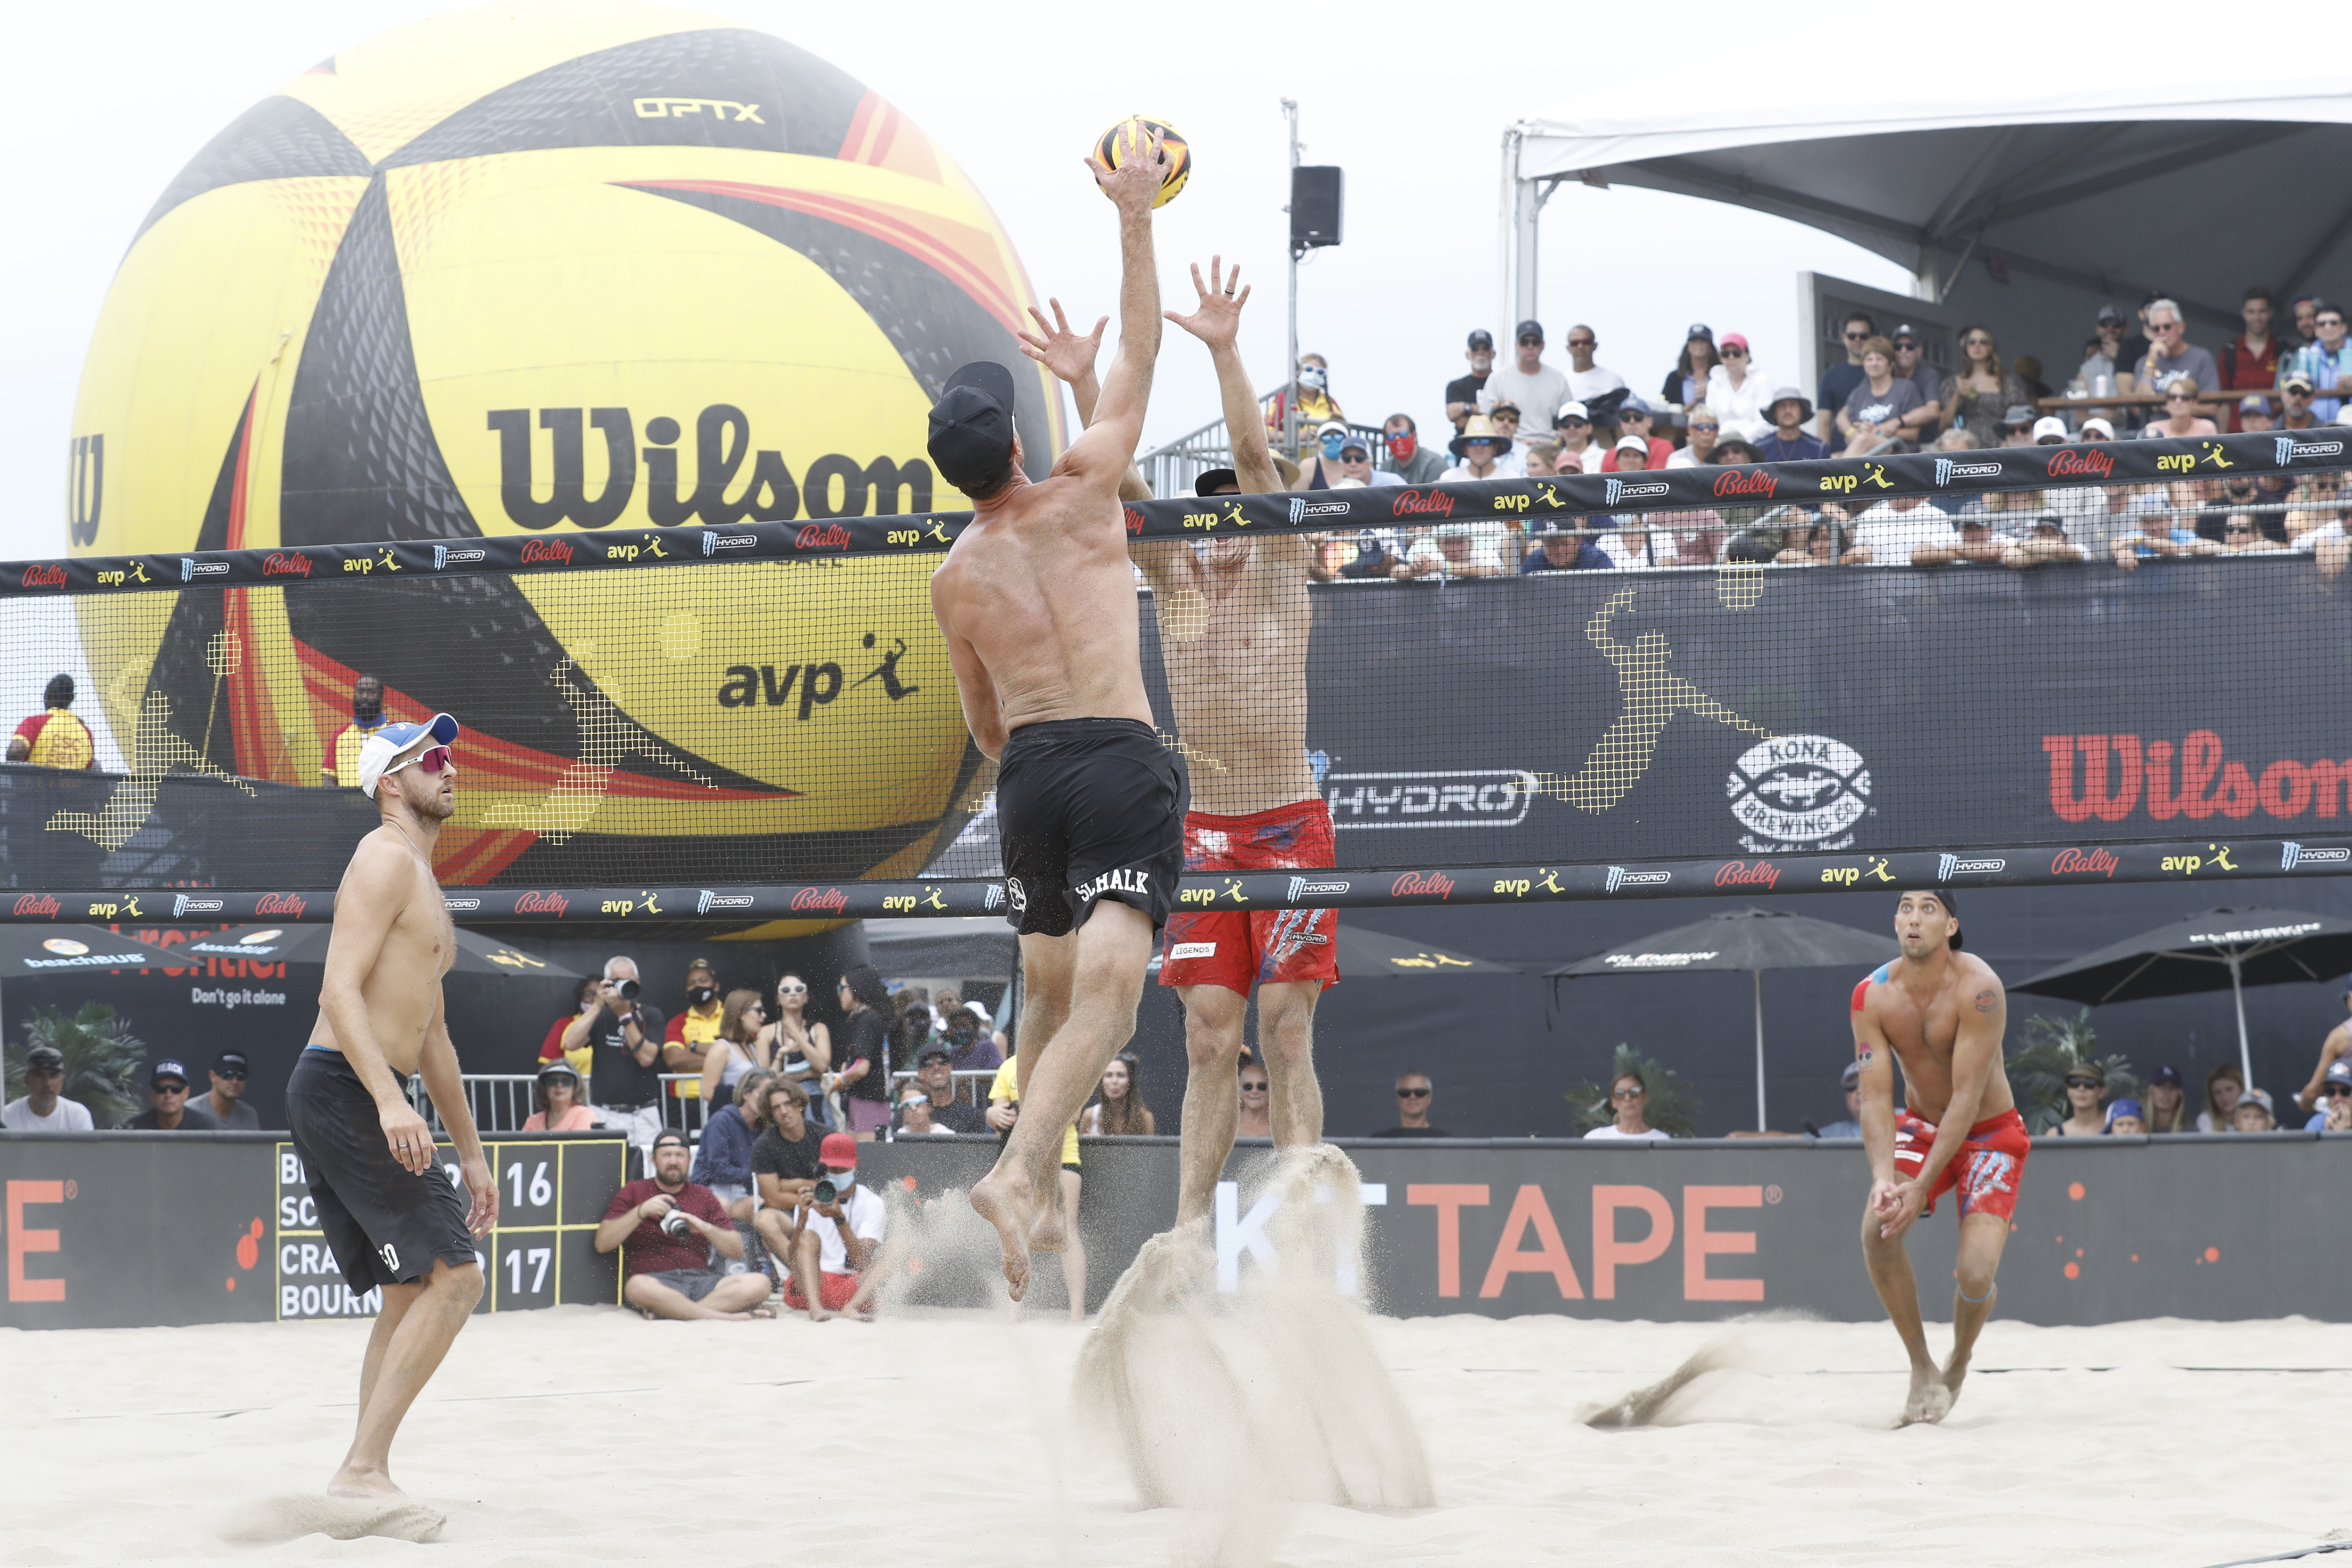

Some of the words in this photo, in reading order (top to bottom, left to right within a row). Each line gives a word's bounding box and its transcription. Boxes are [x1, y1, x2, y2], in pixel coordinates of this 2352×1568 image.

[632, 96, 765, 124] OPTX
[487, 403, 933, 530] Wilson
[22, 565, 68, 588] Bally
[97, 570, 125, 586] avp
[193, 565, 226, 574] HYDRO
[263, 552, 313, 577] Bally
[343, 558, 372, 574] avp
[447, 552, 482, 561] HYDRO
[521, 539, 574, 565] Bally
[607, 545, 639, 561] avp
[715, 537, 754, 547] HYDRO
[795, 524, 852, 552] Bally
[887, 529, 920, 546] avp
[1124, 507, 1145, 535] lly
[1183, 512, 1218, 531] avp
[1305, 504, 1346, 514] HYDRO
[1393, 489, 1455, 518] Bally
[1494, 494, 1530, 512] avp
[1622, 485, 1665, 496] HYDRO
[1714, 469, 1778, 498] Bally
[1820, 474, 1858, 494] avp
[1952, 464, 1997, 475] HYDRO
[2047, 448, 2114, 478] Bally
[2157, 453, 2196, 473] avp
[2292, 443, 2338, 455] HYDRO
[718, 661, 844, 721] avp
[1769, 741, 1828, 762] KONA
[2042, 729, 2352, 822] Wilson
[1327, 783, 1519, 816] HYDRO
[1743, 801, 1829, 834] BREWING
[14, 894, 61, 919] Bally
[89, 903, 117, 919] avp
[255, 893, 306, 919] Bally
[515, 891, 569, 917] Bally
[601, 899, 632, 917] avp
[712, 897, 749, 906] HYDRO
[791, 887, 848, 914] Bally
[882, 896, 916, 912] avp
[1180, 887, 1216, 906] avp
[1303, 883, 1346, 892] HYDRO
[1392, 871, 1455, 900] Bally
[1494, 877, 1530, 897] avp
[1623, 873, 1666, 882] HYDRO
[1715, 860, 1781, 889] Bally
[1821, 865, 1860, 886] avp
[1955, 861, 2001, 871] HYDRO
[2051, 847, 2120, 878] Bally
[2161, 854, 2201, 875] avp
[2299, 850, 2345, 861] HYDRO
[1176, 946, 1210, 955] LEGENDS
[1292, 934, 1326, 943] HYDRO
[23, 953, 146, 968] beachBUB
[191, 987, 226, 1004] Don't
[226, 991, 241, 1009] go
[242, 989, 252, 1004] it
[253, 989, 286, 1005] alone
[155, 1062, 183, 1075] BEACH
[506, 1162, 553, 1207] 16
[505, 1248, 552, 1294] 17
[281, 1284, 383, 1316] BOURN
